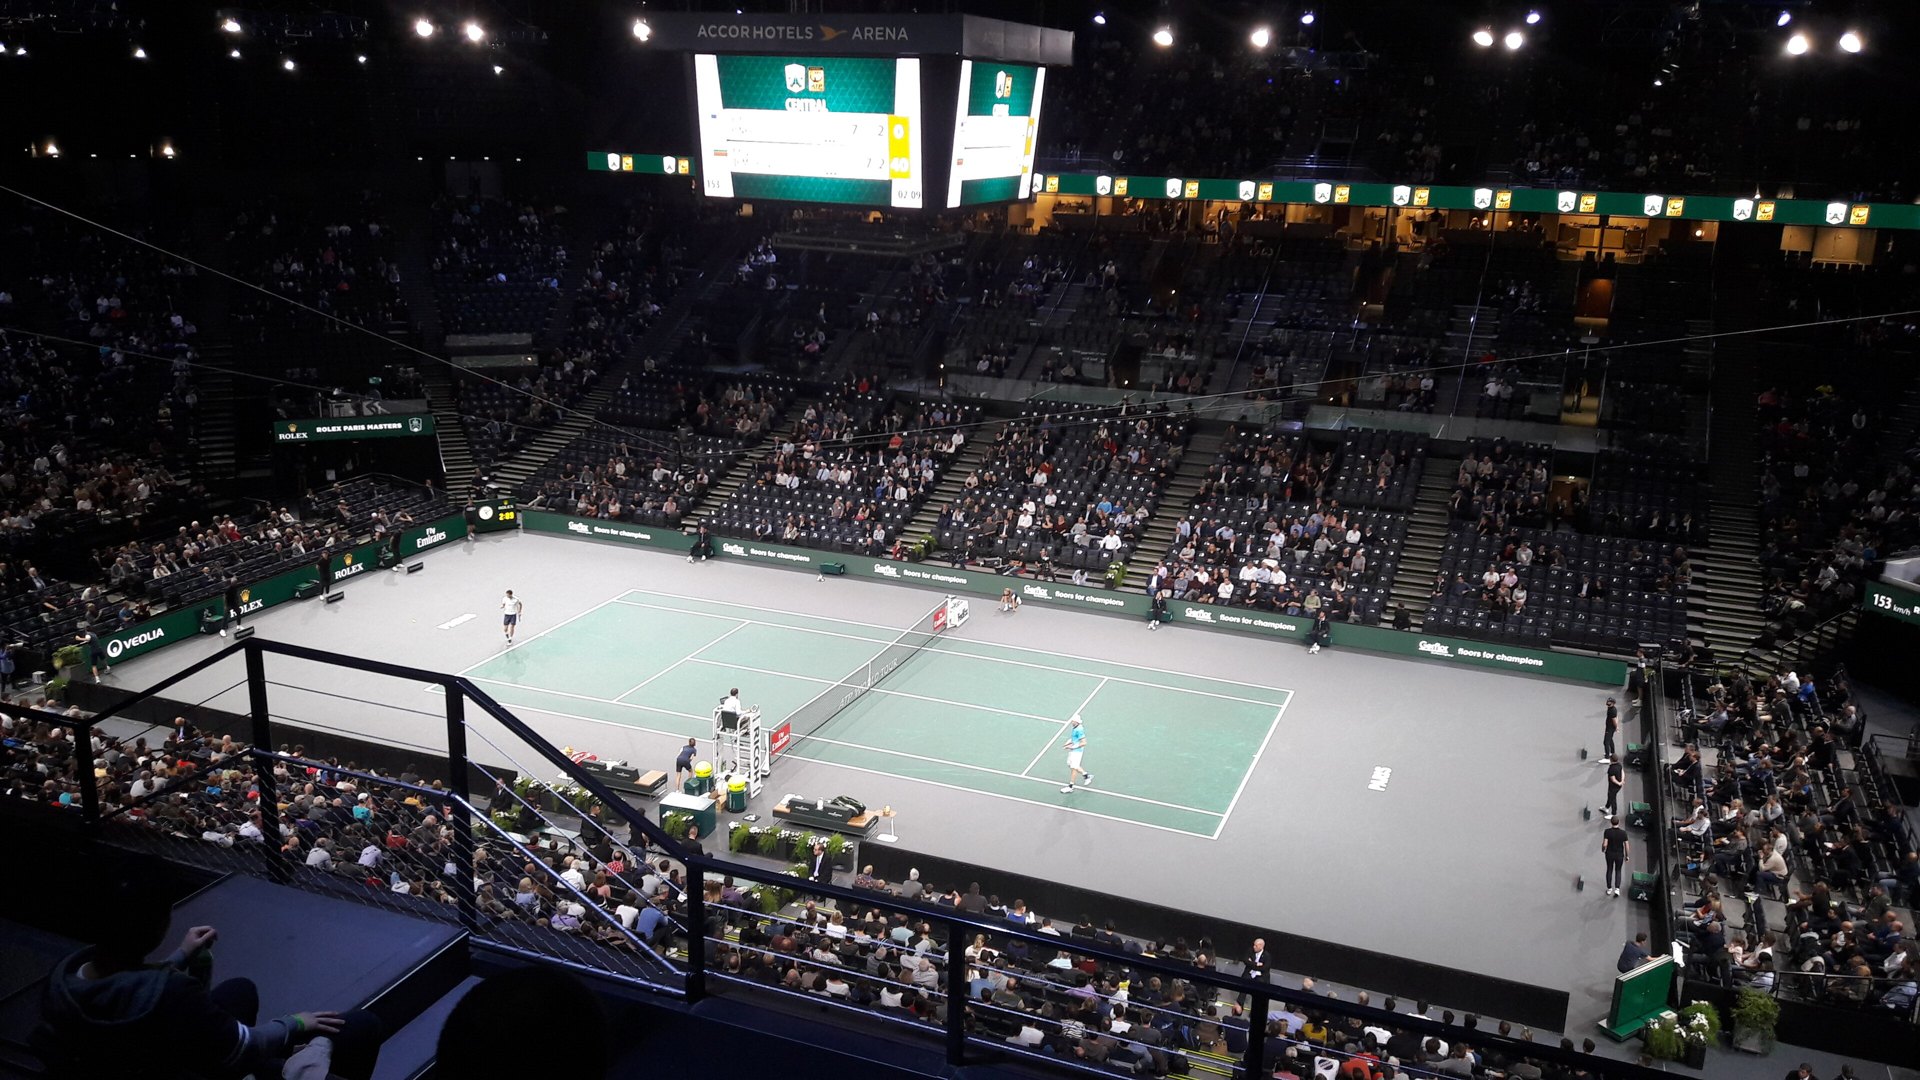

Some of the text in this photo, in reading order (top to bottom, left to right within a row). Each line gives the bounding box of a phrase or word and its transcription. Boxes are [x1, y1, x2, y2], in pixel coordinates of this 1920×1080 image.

[852, 26, 908, 40] ARENA
[852, 123, 905, 140] 7 2 0
[890, 157, 909, 172] 40
[343, 424, 366, 432] PARIS
[366, 422, 402, 431] MASTERS
[279, 432, 308, 440] ROLEX
[426, 527, 436, 535] Fly
[416, 531, 447, 548] Emirates
[777, 552, 810, 562] champions
[334, 562, 364, 580] ROLEX
[932, 573, 967, 584] champions
[1075, 593, 1085, 601] for
[1086, 595, 1124, 606] champions
[1873, 593, 1892, 609] 153
[1893, 604, 1911, 616] km/h
[1219, 613, 1240, 623] floors
[1241, 617, 1252, 625] for
[1253, 619, 1296, 631] champions
[123, 627, 165, 649] VEOLIA
[1457, 647, 1481, 657] floors
[1482, 651, 1495, 660] for
[1496, 653, 1543, 666] champions
[881, 657, 898, 676] TOUR
